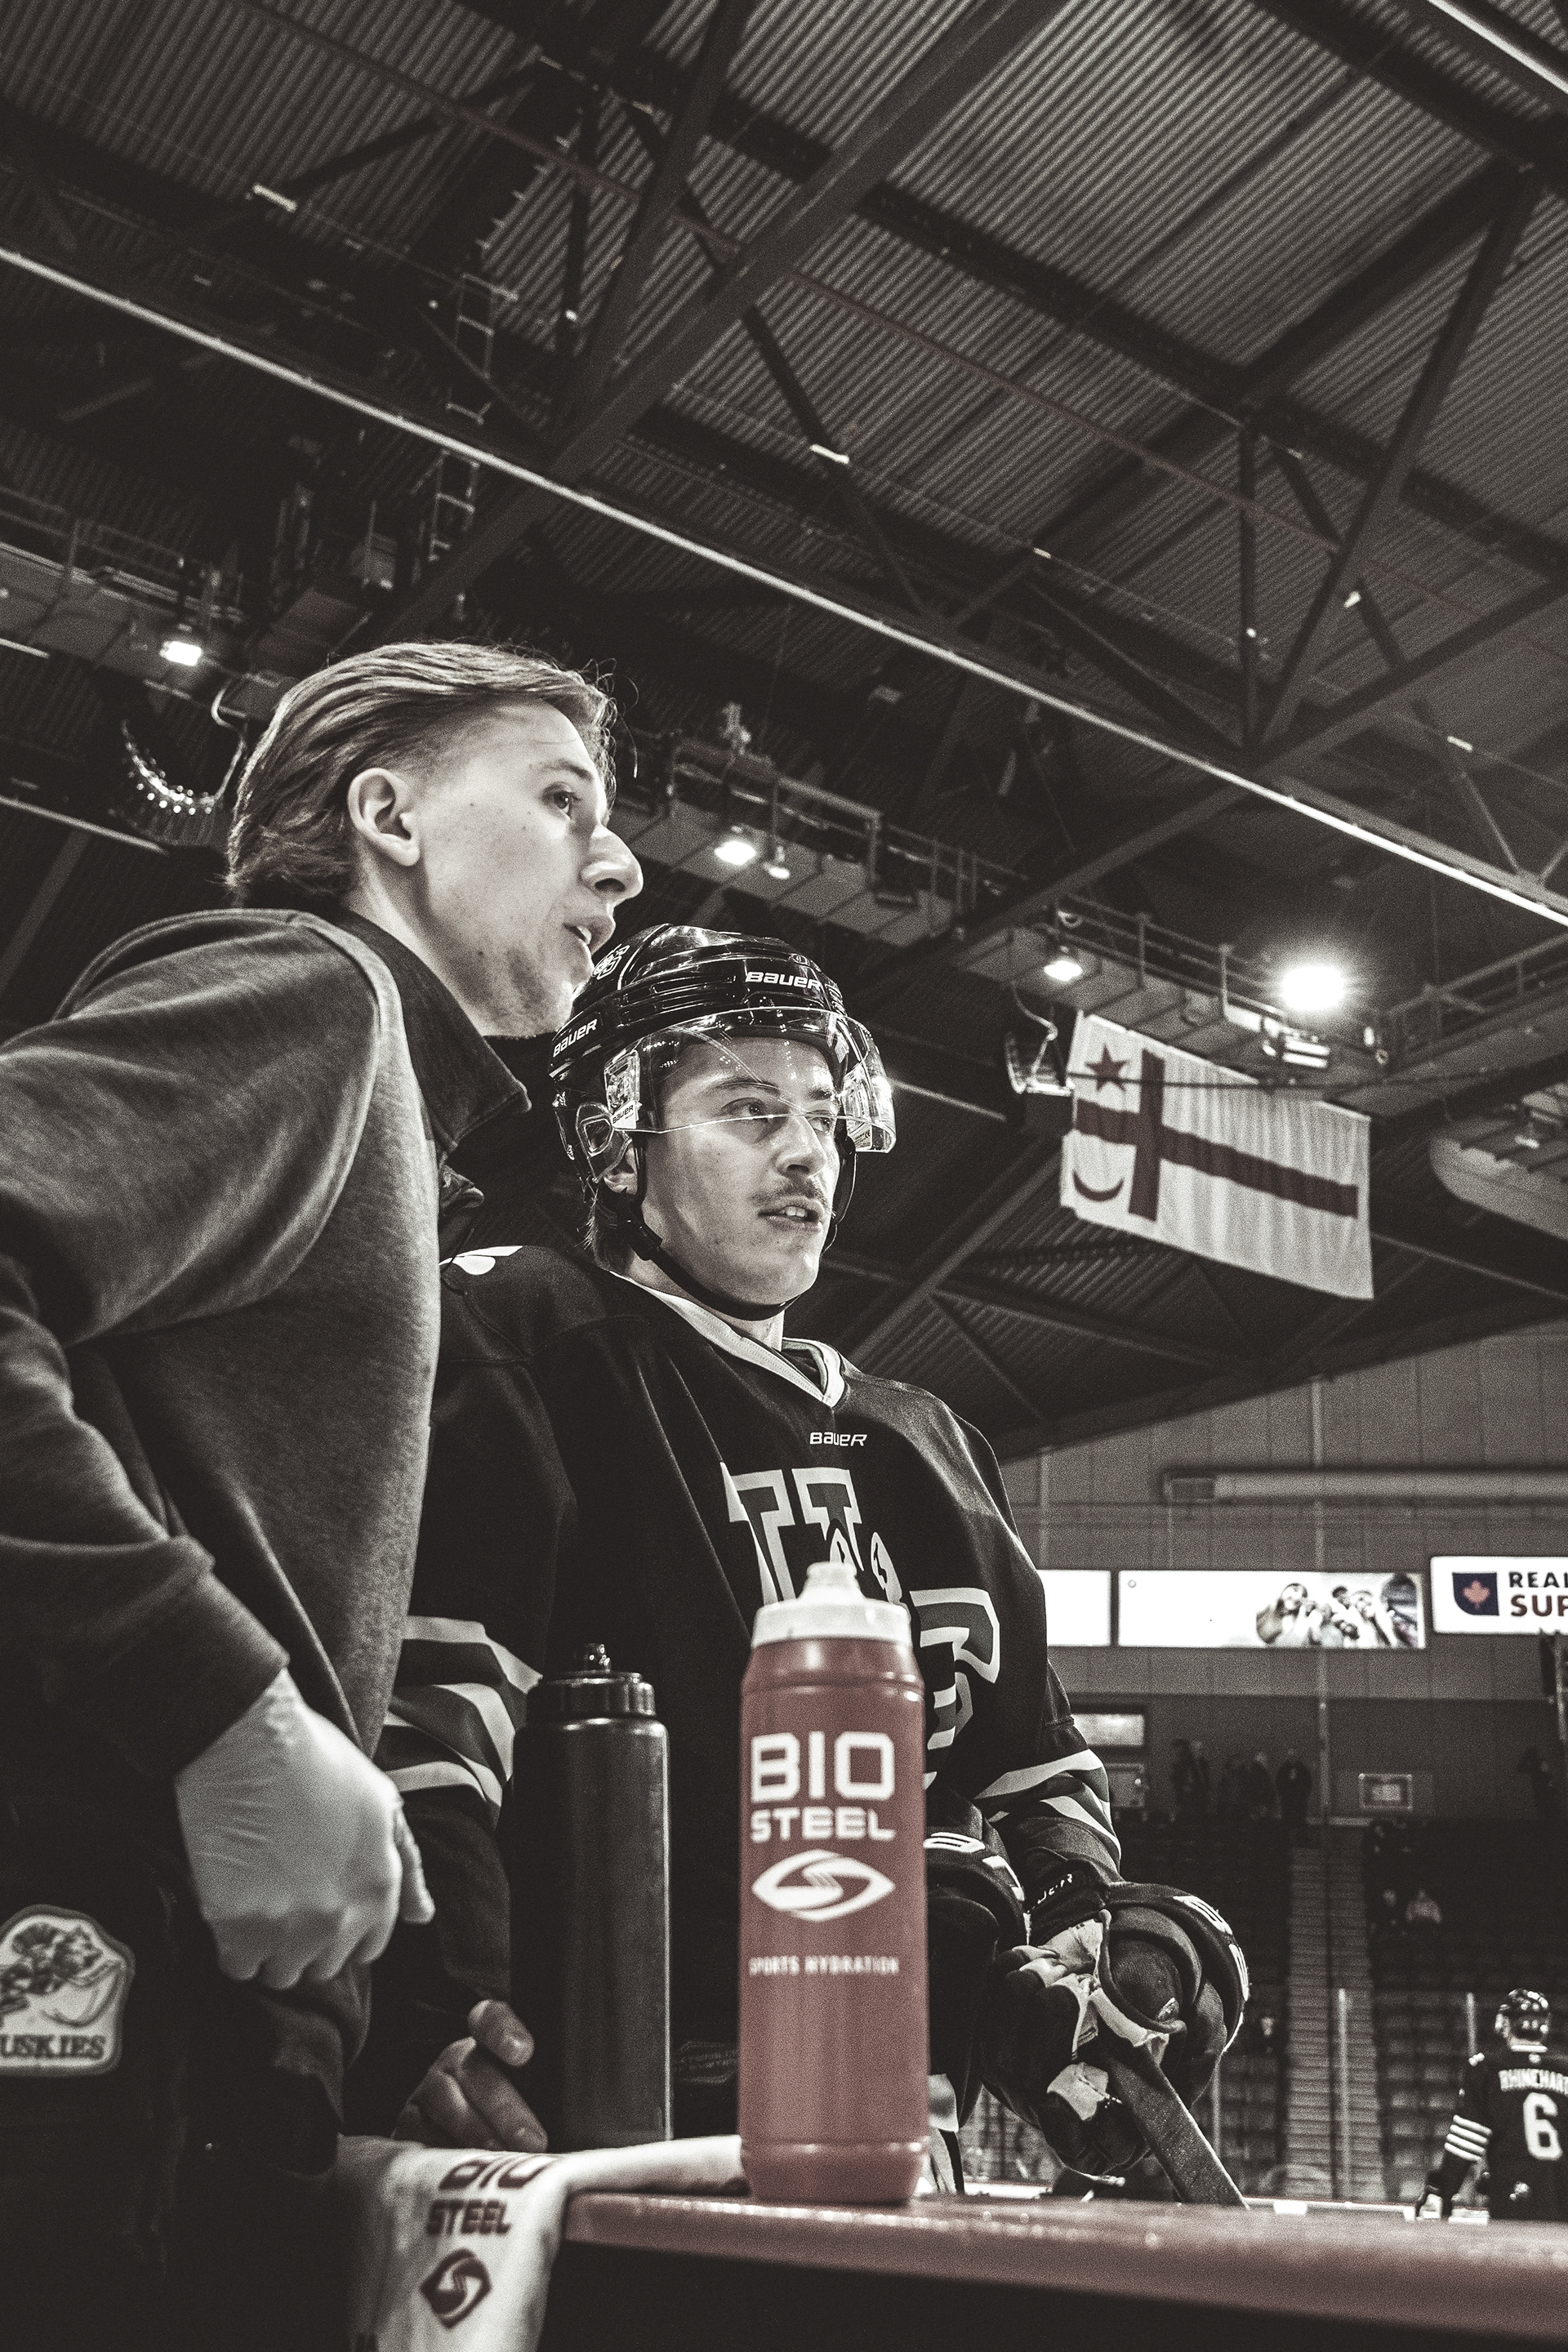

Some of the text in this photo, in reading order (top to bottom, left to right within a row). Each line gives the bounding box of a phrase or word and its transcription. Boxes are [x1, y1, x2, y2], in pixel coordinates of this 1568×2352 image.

[751, 1731, 896, 1803] BIO
[751, 1806, 897, 1843] STEEL
[749, 1954, 900, 1976] SPORTS HYDRATION
[1523, 2092, 1563, 2161] 6
[426, 2199, 513, 2236] STEEL
